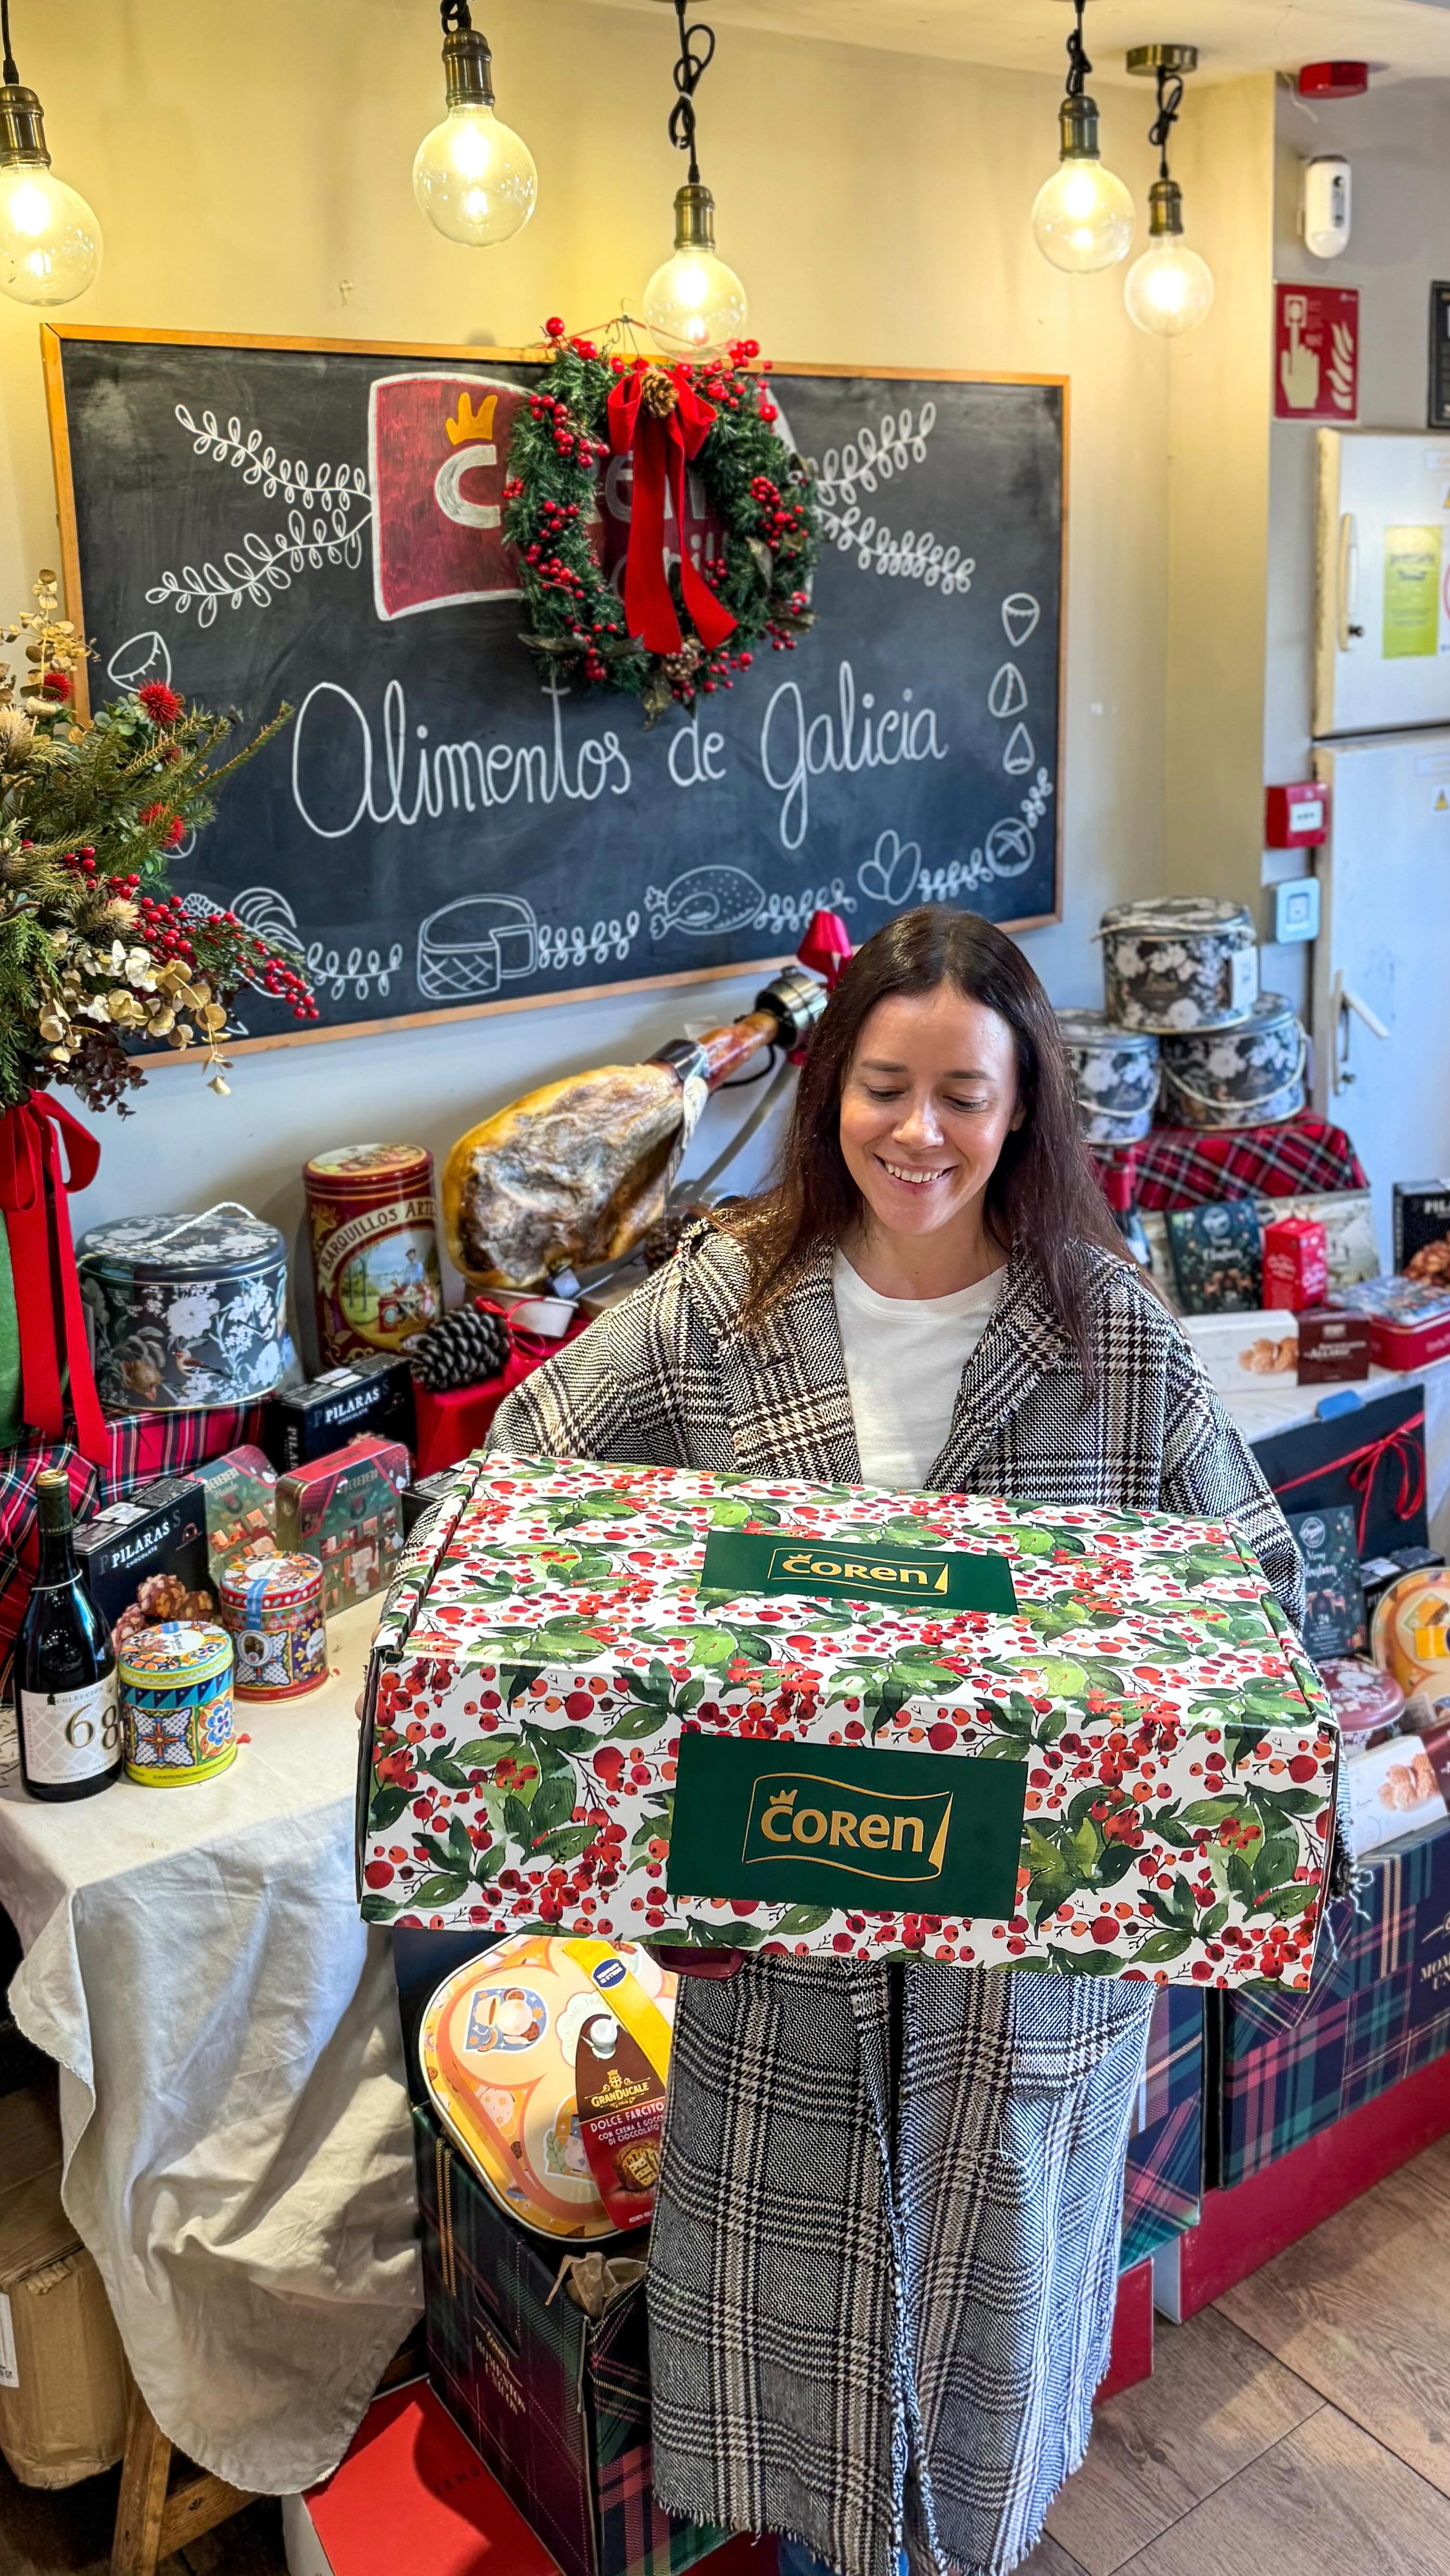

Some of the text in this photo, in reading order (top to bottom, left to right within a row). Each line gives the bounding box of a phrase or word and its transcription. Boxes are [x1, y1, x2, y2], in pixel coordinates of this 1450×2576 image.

[668, 717, 727, 786] de
[321, 1208, 398, 1271] BARQUILLOS
[326, 1388, 380, 1423] PILARAS
[111, 1521, 170, 1569] PILARAS
[125, 1545, 158, 1568] CHOCOLATE
[65, 1702, 119, 1751] 68
[590, 2114, 623, 2133] DOLCE
[625, 2101, 665, 2122] FARCITO
[617, 2123, 660, 2142] CIOCCOLATO
[598, 2131, 613, 2141] CON
